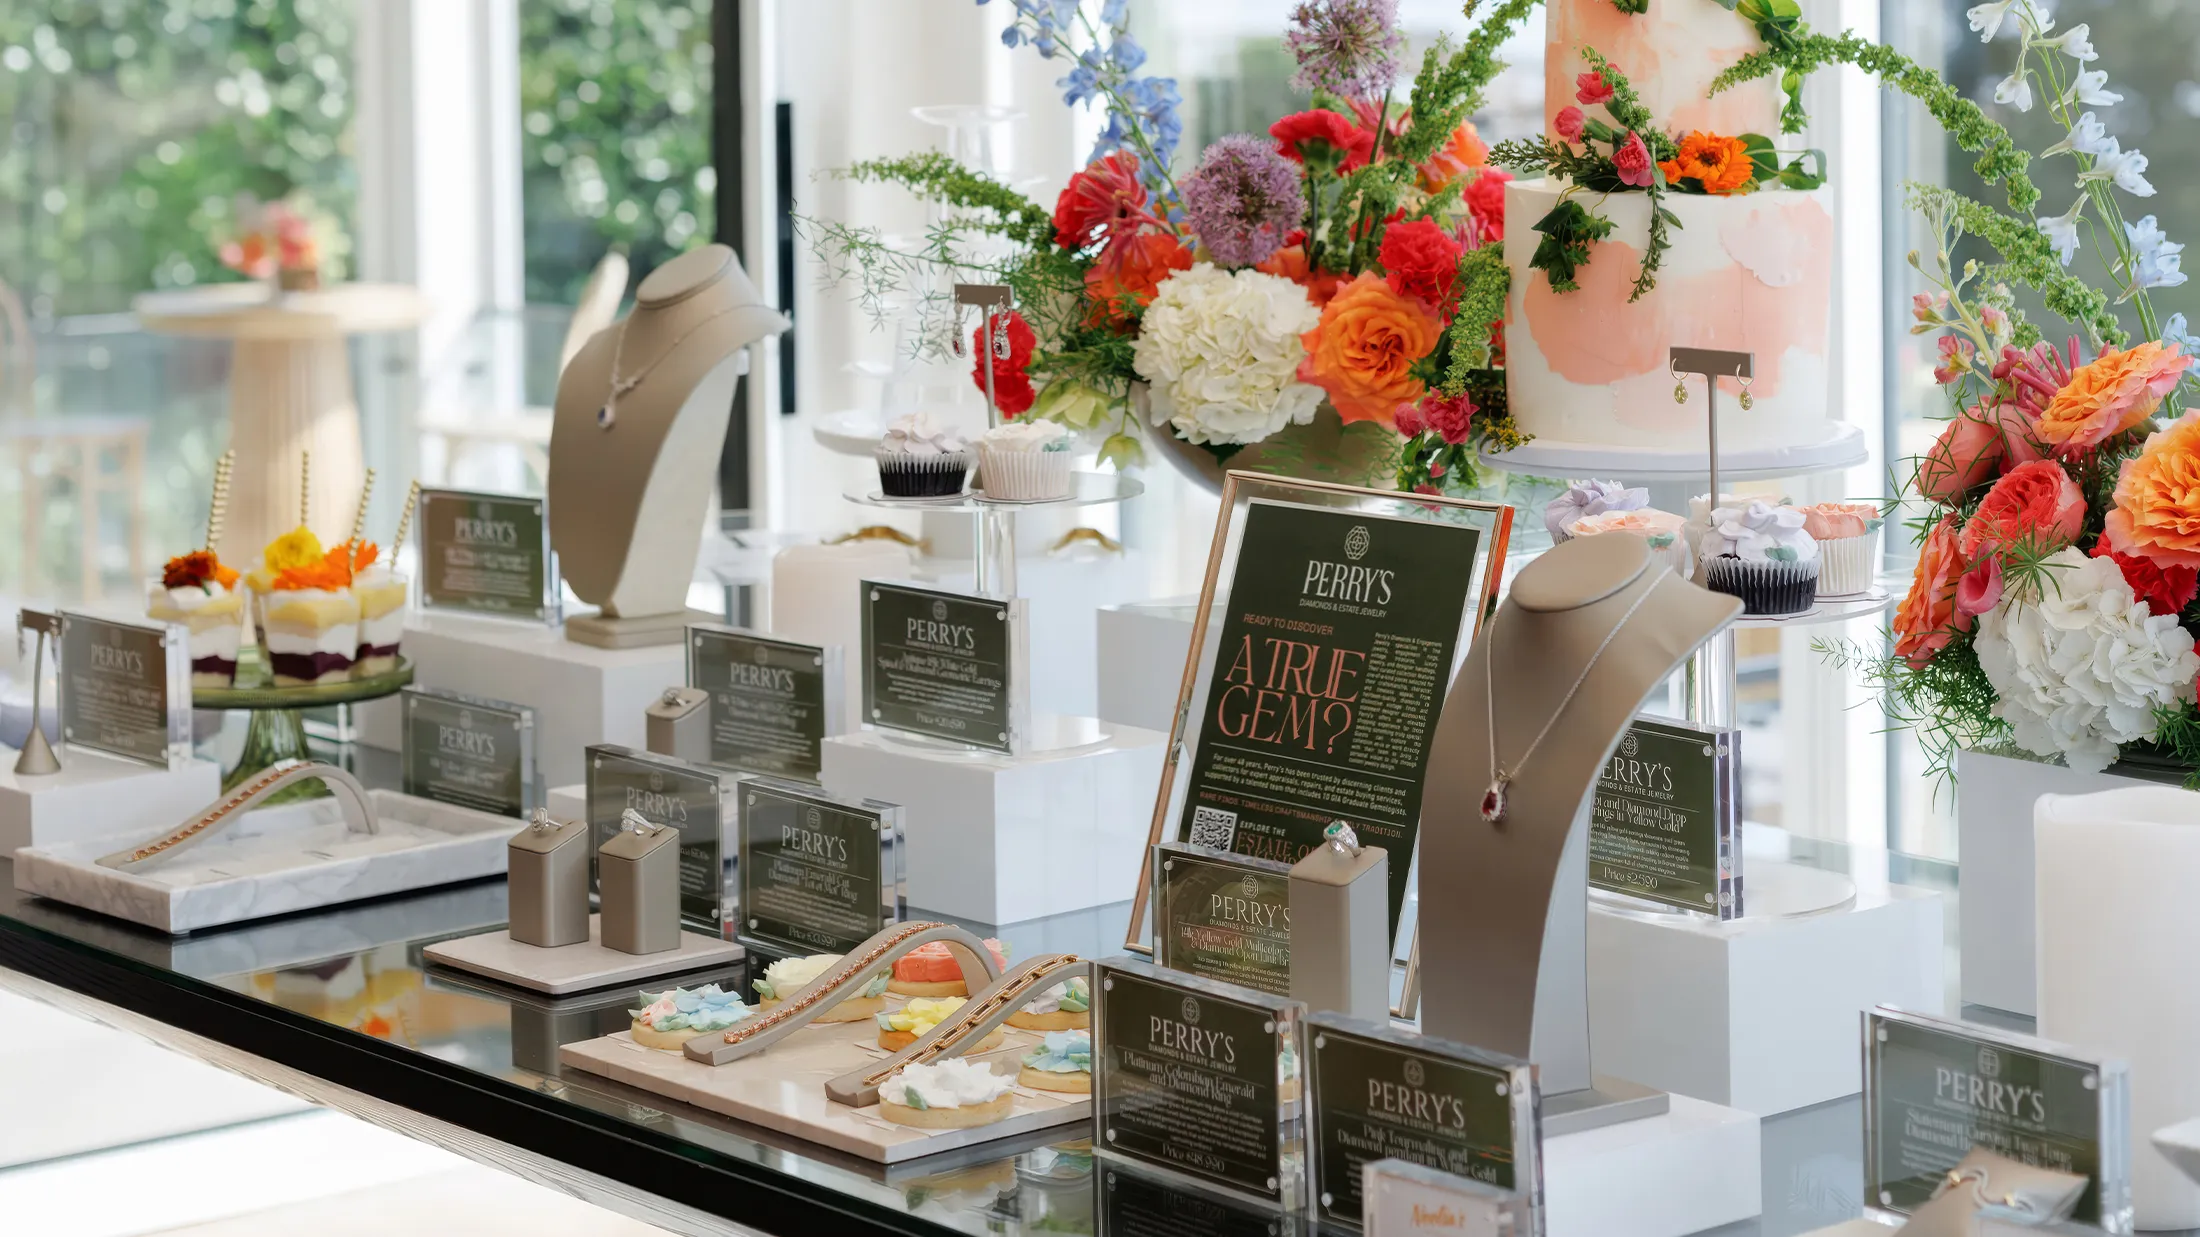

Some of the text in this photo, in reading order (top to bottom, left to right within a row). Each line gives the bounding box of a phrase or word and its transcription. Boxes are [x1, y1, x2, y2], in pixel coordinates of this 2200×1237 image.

[1302, 560, 1394, 605] PERRY'S
[1298, 598, 1387, 618] DIAMONDS & ESTATE JEWELRY
[907, 617, 974, 649] PERRY'S
[1242, 612, 1334, 636] READY TO DISCOVER
[730, 662, 794, 692] PERRY'S
[1224, 633, 1366, 702] A TRUE
[1218, 684, 1352, 754] GEM?
[440, 725, 495, 756] PERRY'S
[1212, 753, 1224, 762] For
[1223, 755, 1236, 764] over
[1263, 762, 1284, 773] Perry's
[1284, 766, 1295, 775] has
[1296, 768, 1311, 778] been
[1311, 771, 1333, 783] trusted
[1333, 775, 1341, 784] by
[1341, 777, 1372, 790] discerning
[1373, 783, 1393, 794] clients
[1394, 787, 1406, 797] and
[1248, 770, 1268, 780] expert
[1268, 773, 1300, 786] appraisals,
[1300, 780, 1323, 790] repairs,
[1323, 784, 1335, 792] and
[1335, 786, 1354, 796] estate
[1355, 790, 1375, 800] buying
[1597, 779, 1617, 790] MONDS
[1624, 784, 1645, 795] ESTATE
[1647, 789, 1674, 801] JEWELRY
[1602, 757, 1672, 792] ERRY'S
[626, 787, 687, 821] PERRY'S
[1232, 775, 1240, 783] by
[1244, 778, 1268, 789] talented
[1268, 782, 1284, 792] team
[1283, 785, 1296, 794] that
[1296, 788, 1321, 799] includes
[1329, 794, 1341, 803] GIA
[1341, 796, 1368, 809] Graduate
[1369, 802, 1407, 816] Gemologists.
[1603, 795, 1619, 810] and
[1622, 799, 1660, 819] Diamond
[1663, 807, 1686, 827] Drop
[1239, 820, 1285, 836] EXPLORE THE
[1362, 823, 1403, 838] TRADITION.
[1592, 806, 1679, 833] rings in Yellow Gold
[782, 825, 847, 861] PERRY'S
[1603, 866, 1624, 882] Price
[1209, 917, 1289, 940] DIAMONDS & ESTATE JEWELR
[1211, 894, 1290, 932] PERRY'S
[789, 926, 805, 938] Price
[1195, 928, 1220, 945] Yellow
[1223, 933, 1242, 950] Gold
[1199, 939, 1234, 957] Diamond
[1150, 1016, 1234, 1064] PERRY'S
[1148, 1043, 1180, 1059] DIAMONDS
[1185, 1053, 1207, 1066] ESTATE
[1210, 1059, 1236, 1074] JEWELRY
[1124, 1050, 1162, 1073] Platinum
[1215, 1076, 1254, 1100] Emerald
[1149, 1070, 1231, 1109] and Diamond Ring
[1368, 1078, 1465, 1129] PERRY'S
[1937, 1067, 2045, 1122] PERRY'S
[1162, 1142, 1183, 1161] Price
[1338, 1129, 1382, 1154] Diamond
[1472, 1163, 1497, 1184] Gold
[1447, 1144, 1467, 1164] and
